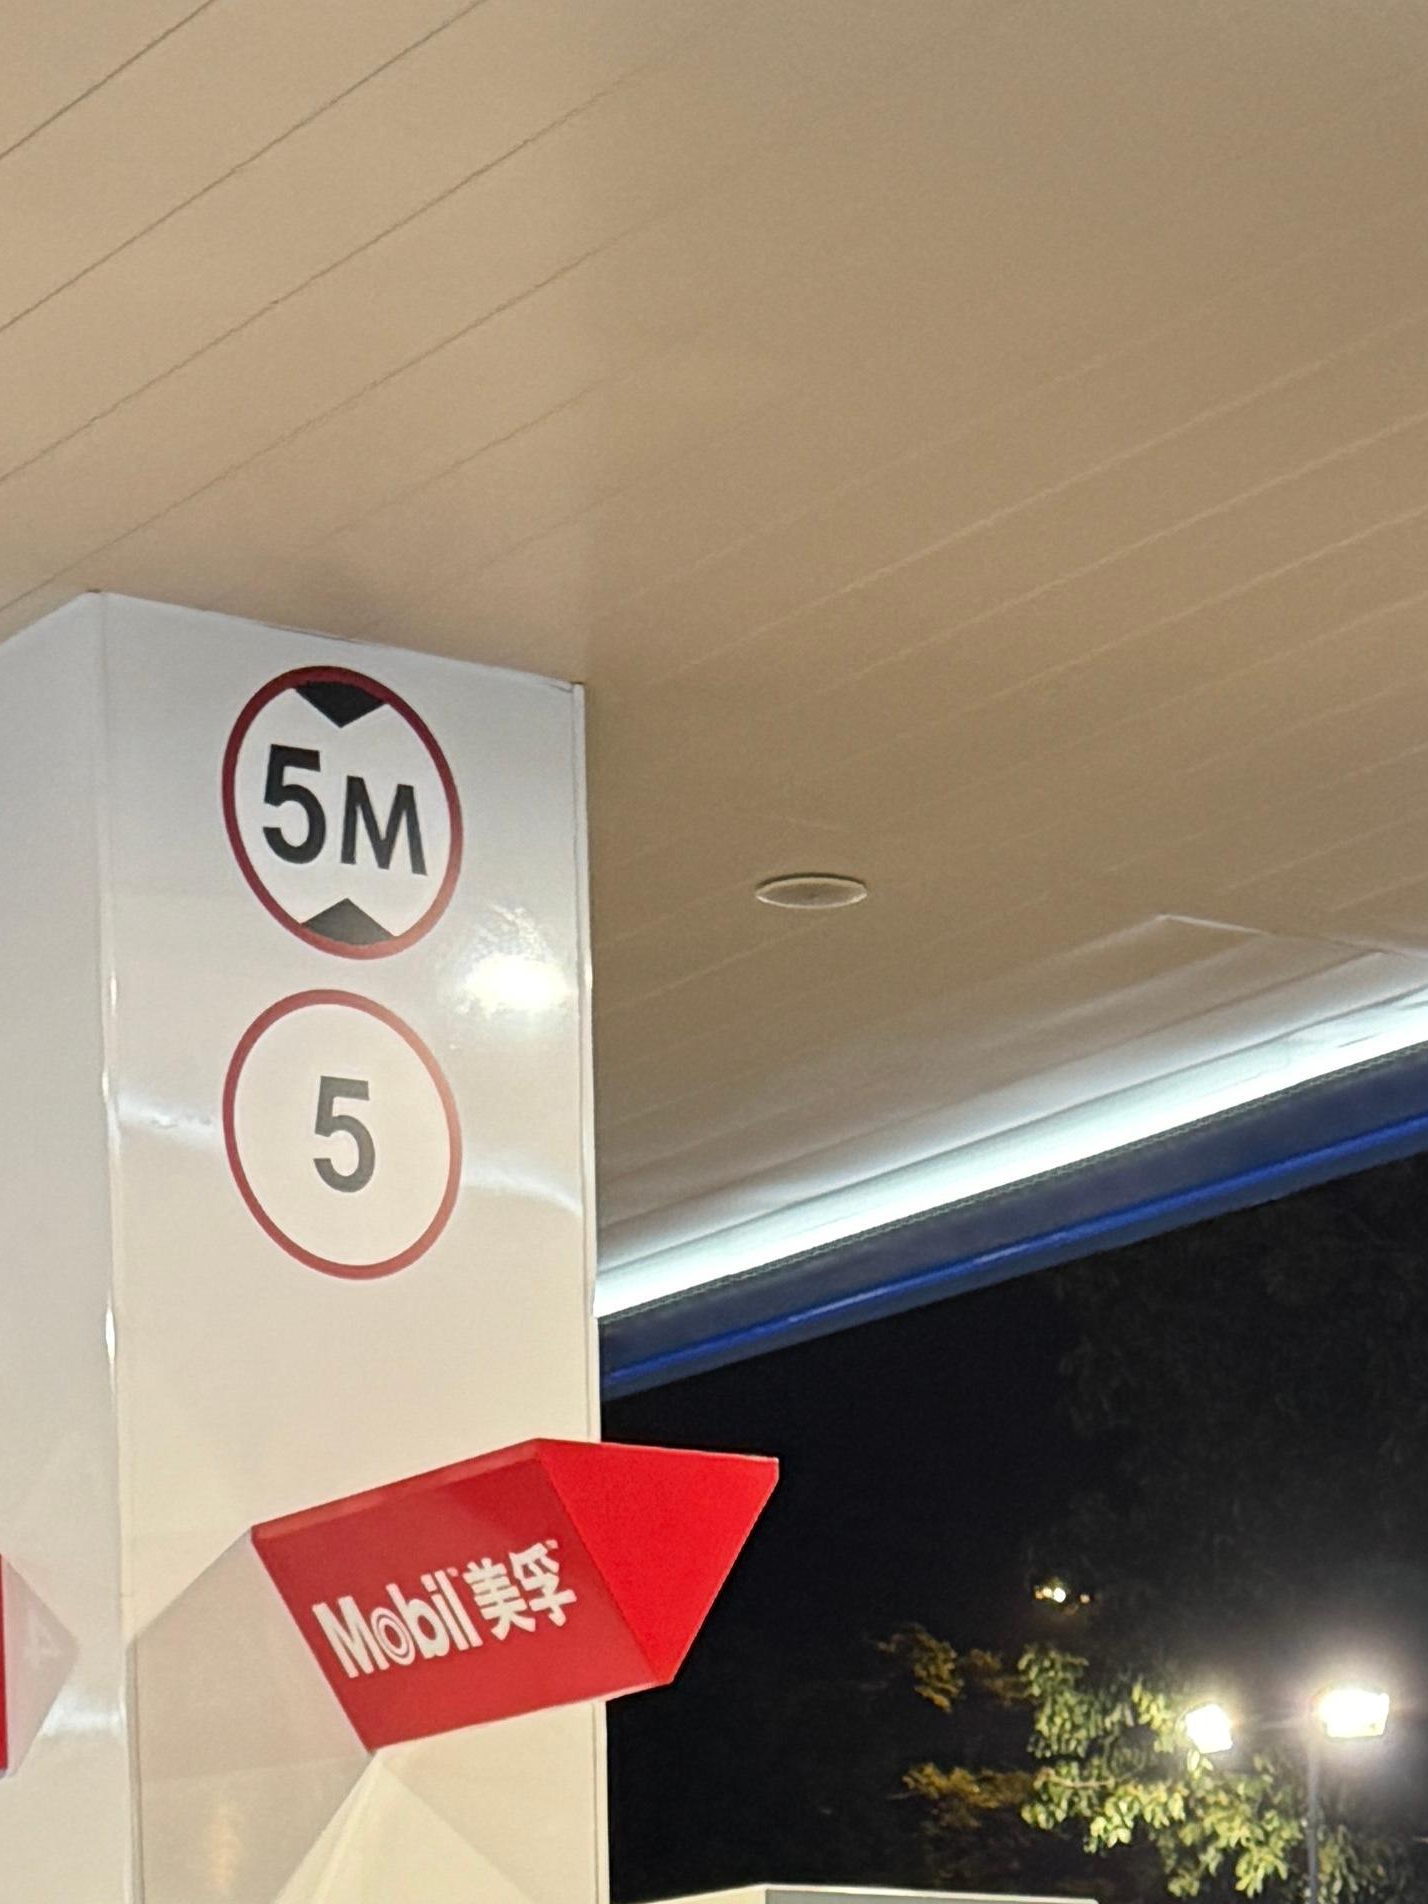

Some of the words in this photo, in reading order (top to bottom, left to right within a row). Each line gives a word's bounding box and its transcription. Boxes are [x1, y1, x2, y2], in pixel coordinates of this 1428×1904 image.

[262, 743, 428, 876] 5M
[311, 1074, 375, 1194] 5
[312, 1569, 484, 1679] Mobil
[462, 1540, 578, 1641] 美孚
